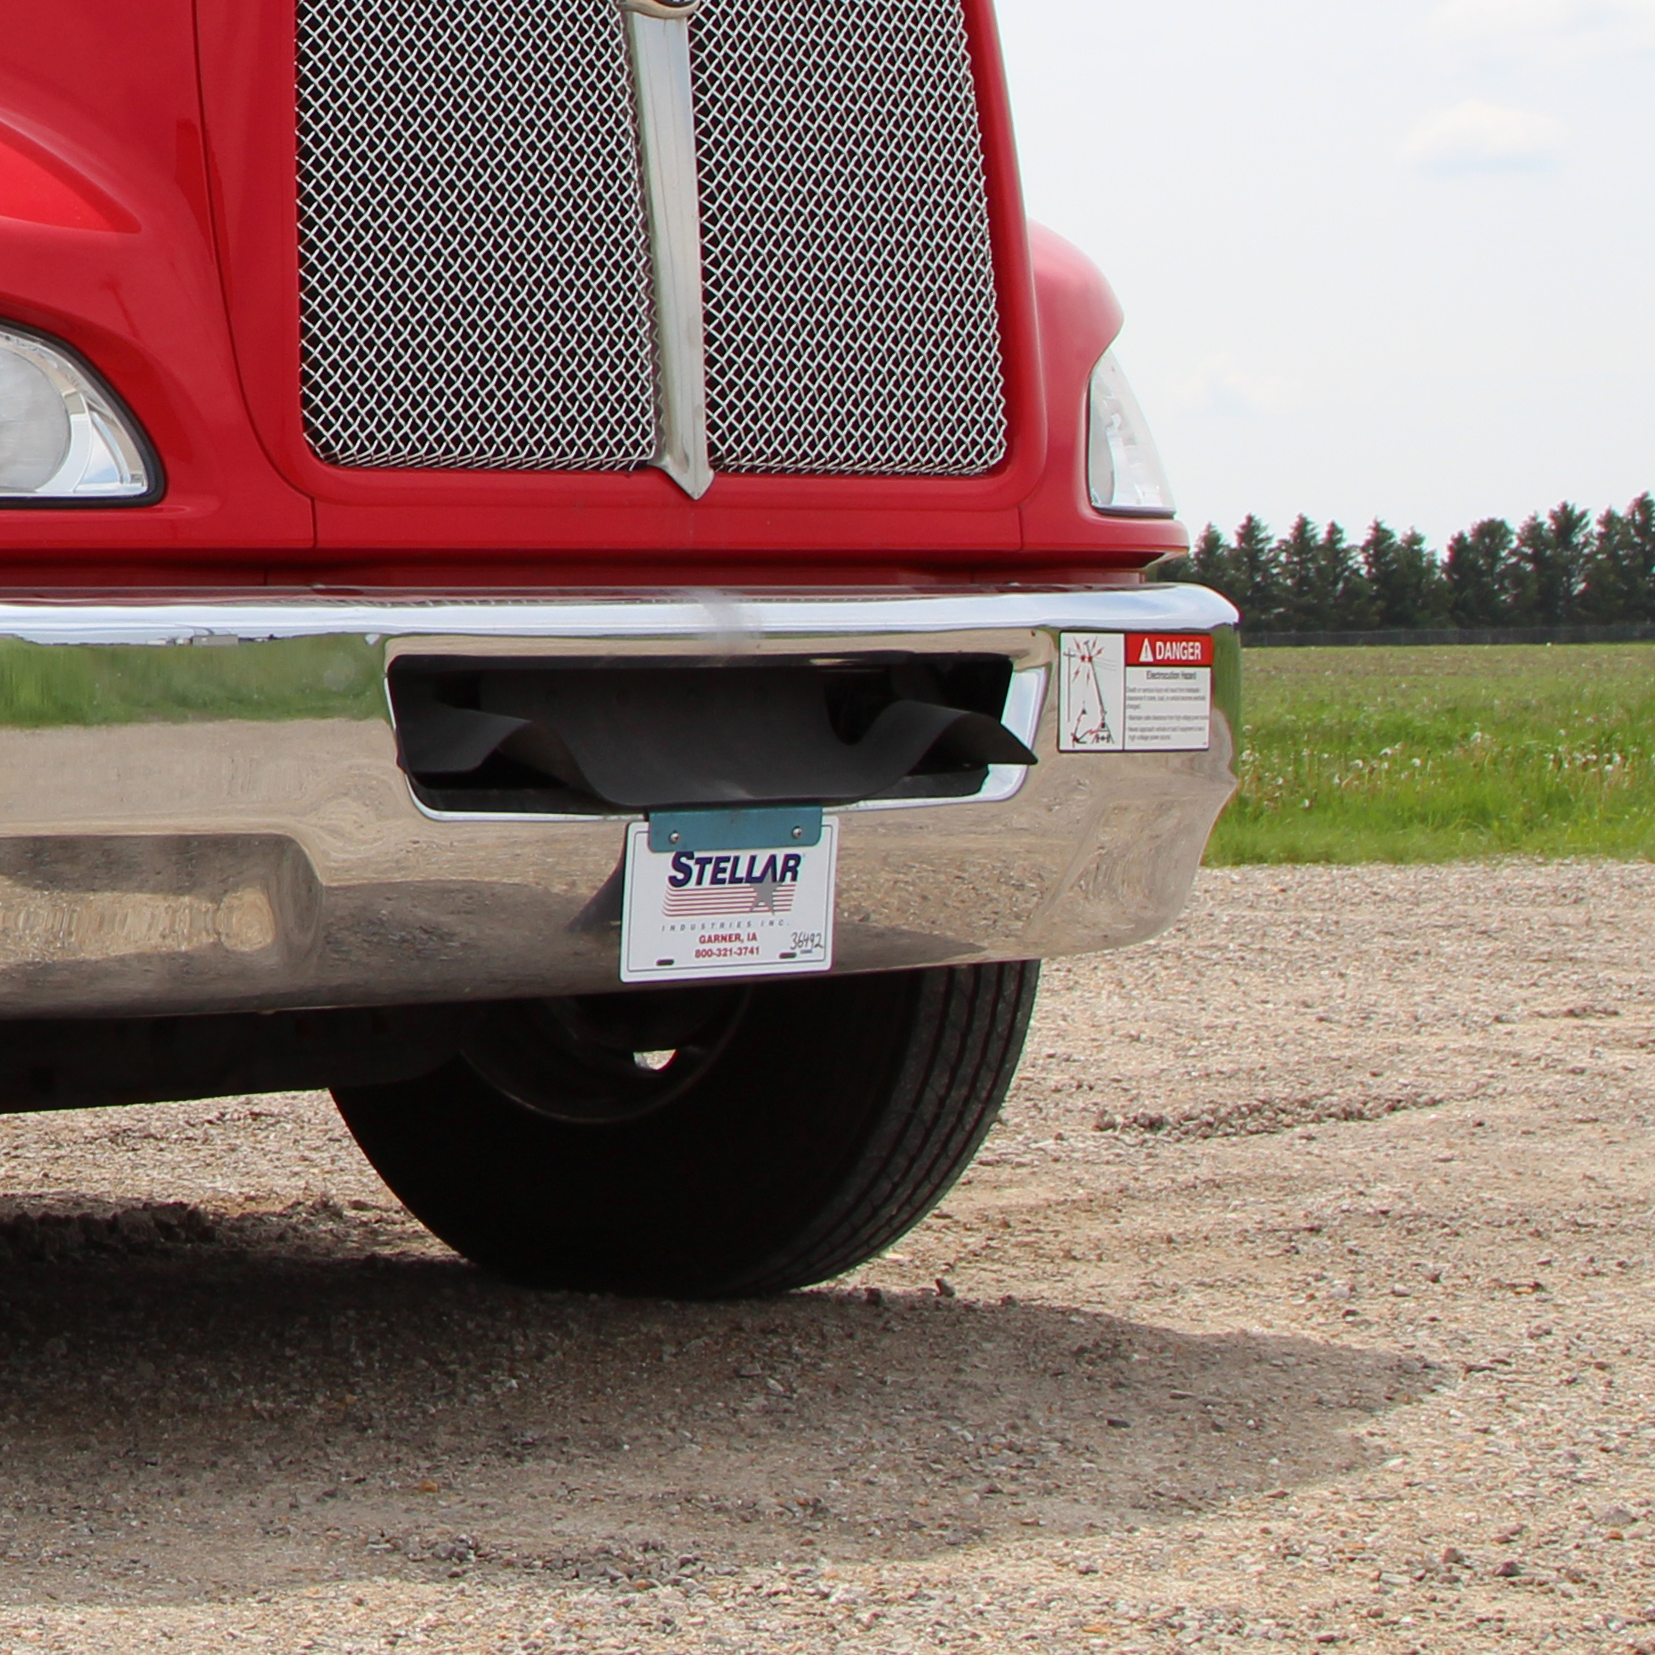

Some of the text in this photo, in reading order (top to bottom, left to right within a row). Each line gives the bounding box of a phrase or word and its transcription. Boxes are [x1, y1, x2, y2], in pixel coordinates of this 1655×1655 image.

[1155, 641, 1202, 661] DANGER
[667, 851, 803, 888] STELLAR
[661, 918, 790, 932] INDUSTRIES INC.
[698, 932, 758, 945] GARNER, IA
[790, 932, 824, 951] 36492
[694, 946, 760, 959] 800-321-3741
